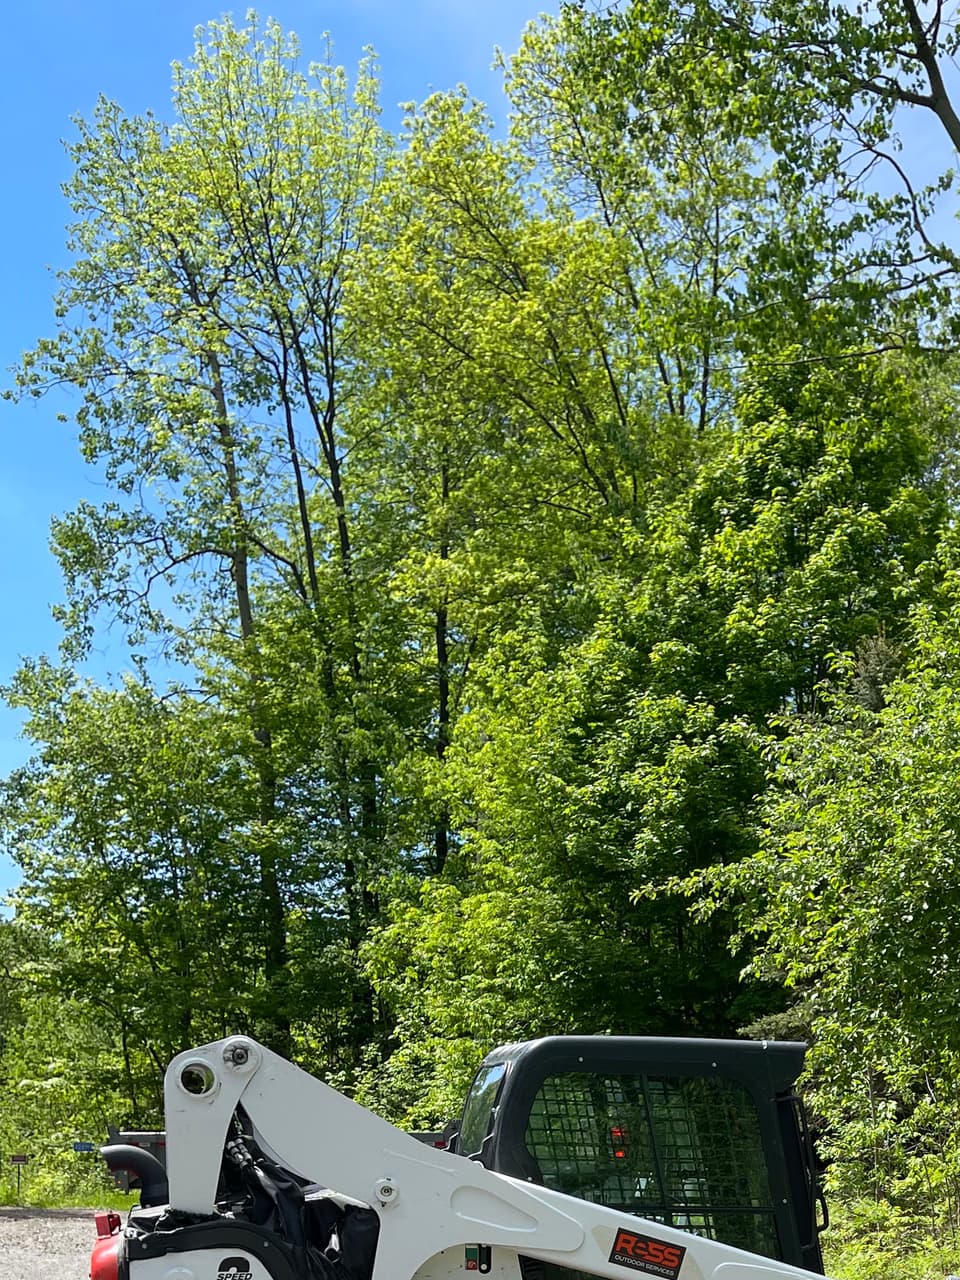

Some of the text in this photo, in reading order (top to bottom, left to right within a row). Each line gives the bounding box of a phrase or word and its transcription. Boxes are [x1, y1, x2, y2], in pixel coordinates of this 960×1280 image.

[614, 1254, 675, 1276] OUTDOOR SERVICES
[216, 1272, 253, 1280] SPEED
